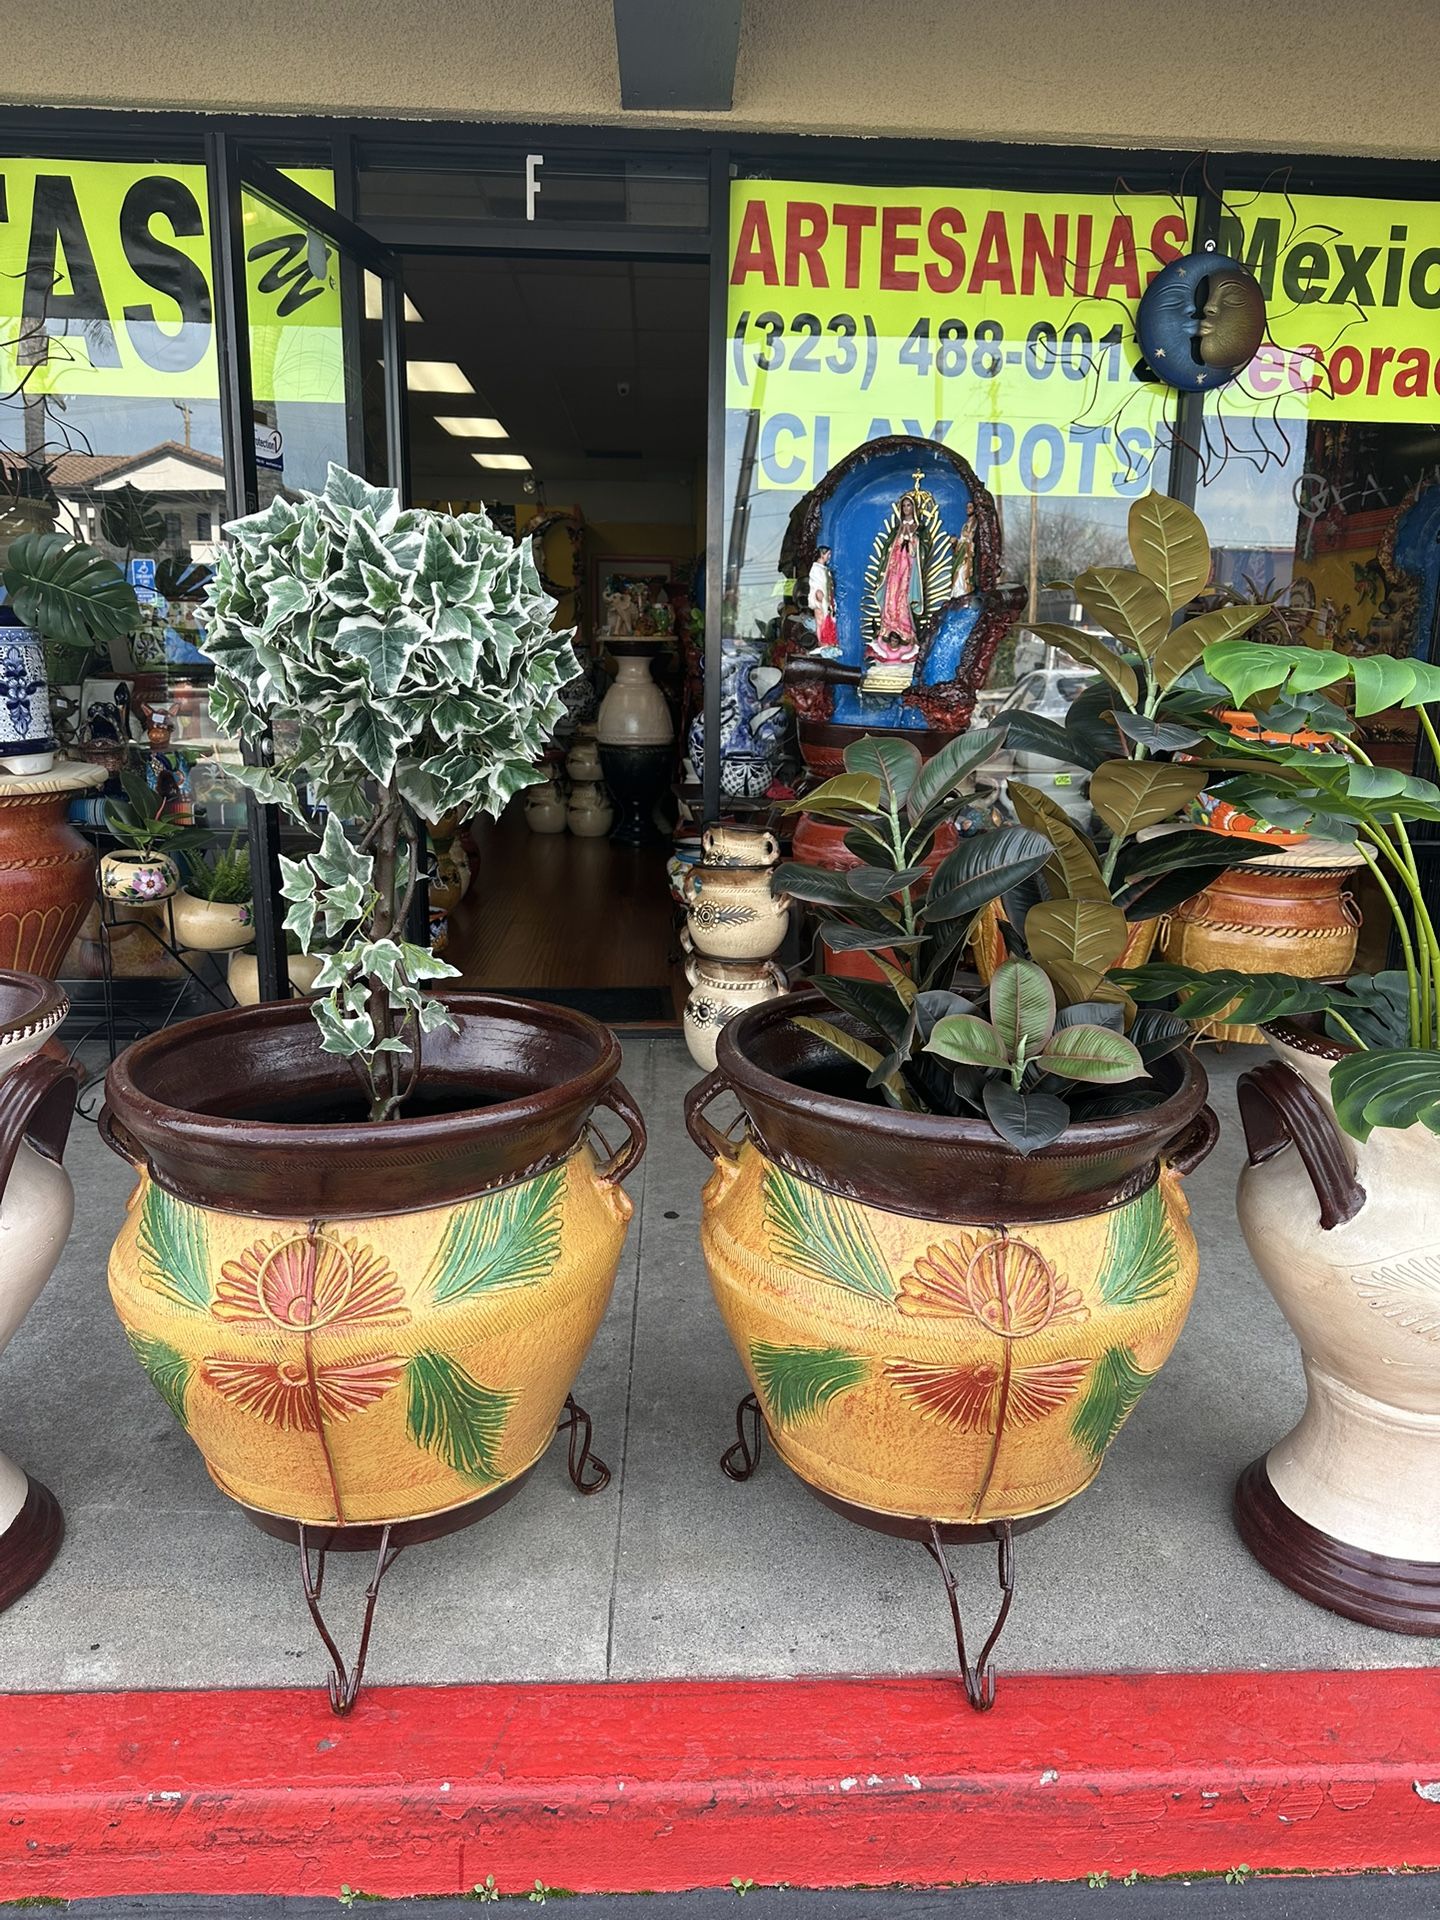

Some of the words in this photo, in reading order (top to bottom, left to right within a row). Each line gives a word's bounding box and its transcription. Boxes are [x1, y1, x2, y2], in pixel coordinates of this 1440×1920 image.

[526, 155, 543, 220] F
[0, 174, 212, 373] AS
[733, 311, 878, 390] (323)
[976, 422, 1152, 496] POTS
